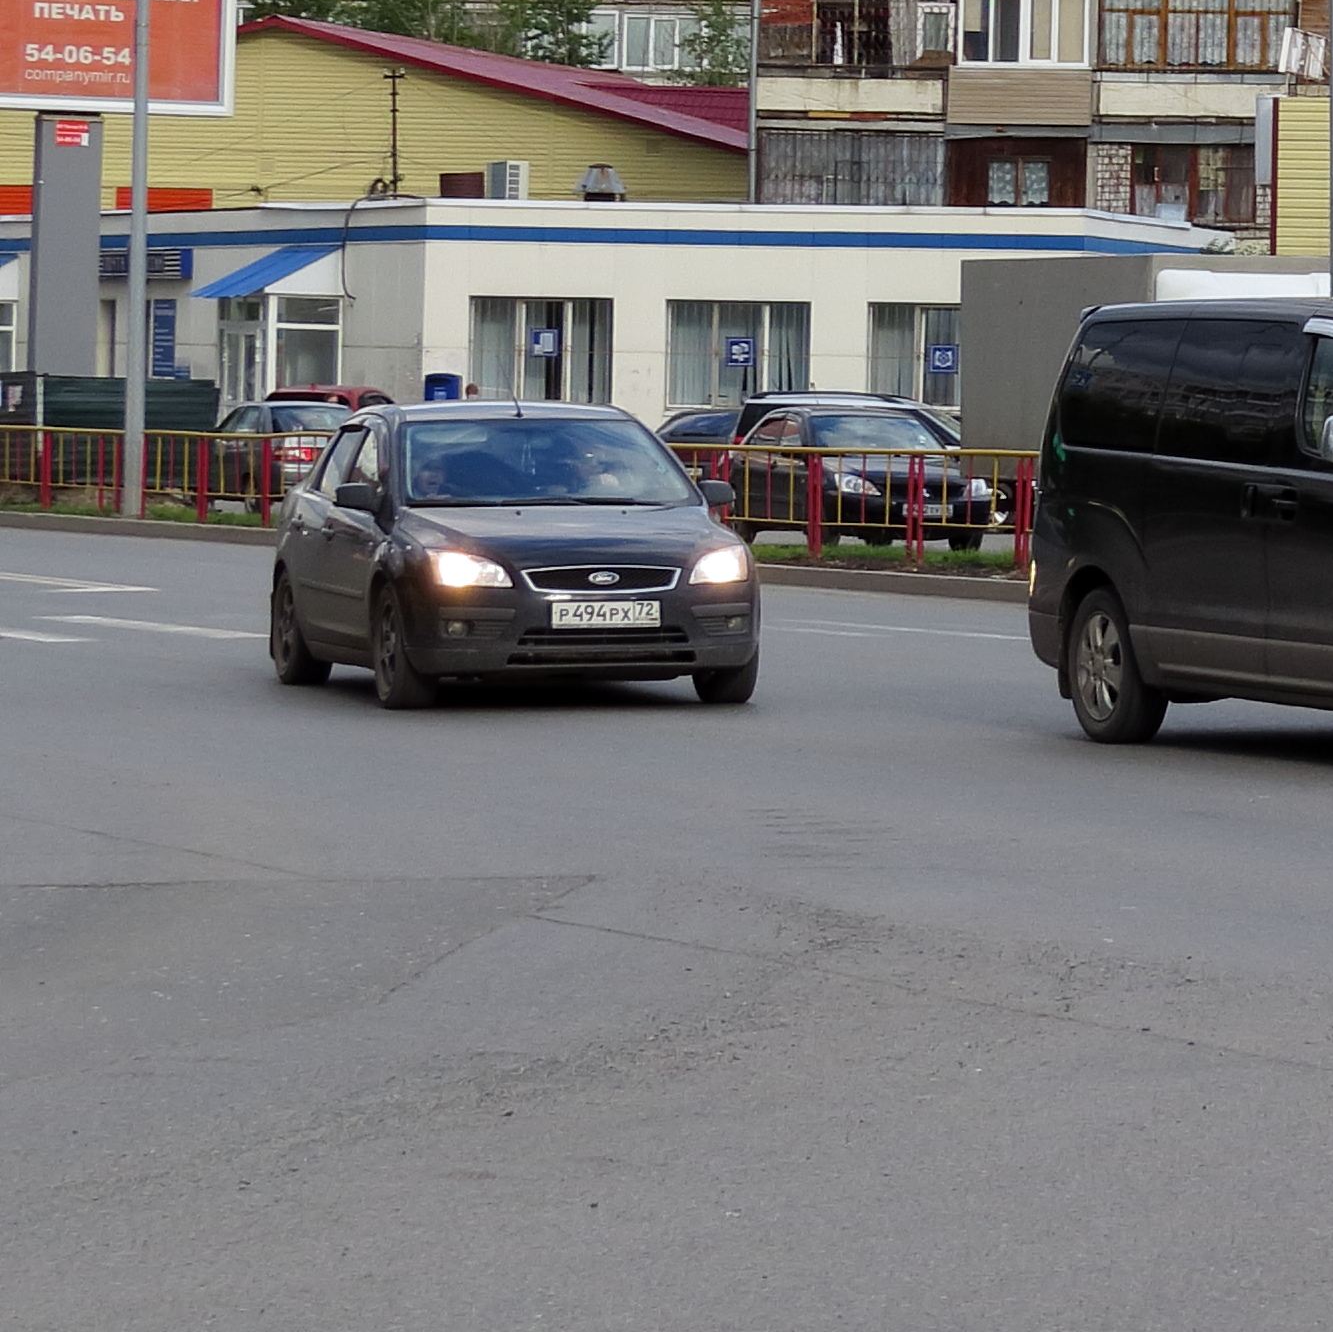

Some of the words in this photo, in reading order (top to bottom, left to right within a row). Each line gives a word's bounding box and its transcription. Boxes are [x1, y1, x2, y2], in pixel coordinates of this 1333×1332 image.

[33, 2, 125, 22] ПЕЧАТЬ
[25, 44, 131, 65] 54-06-54
[25, 69, 131, 85] companymir.ru
[559, 604, 632, 622] Р494РХ
[636, 602, 654, 616] 72
